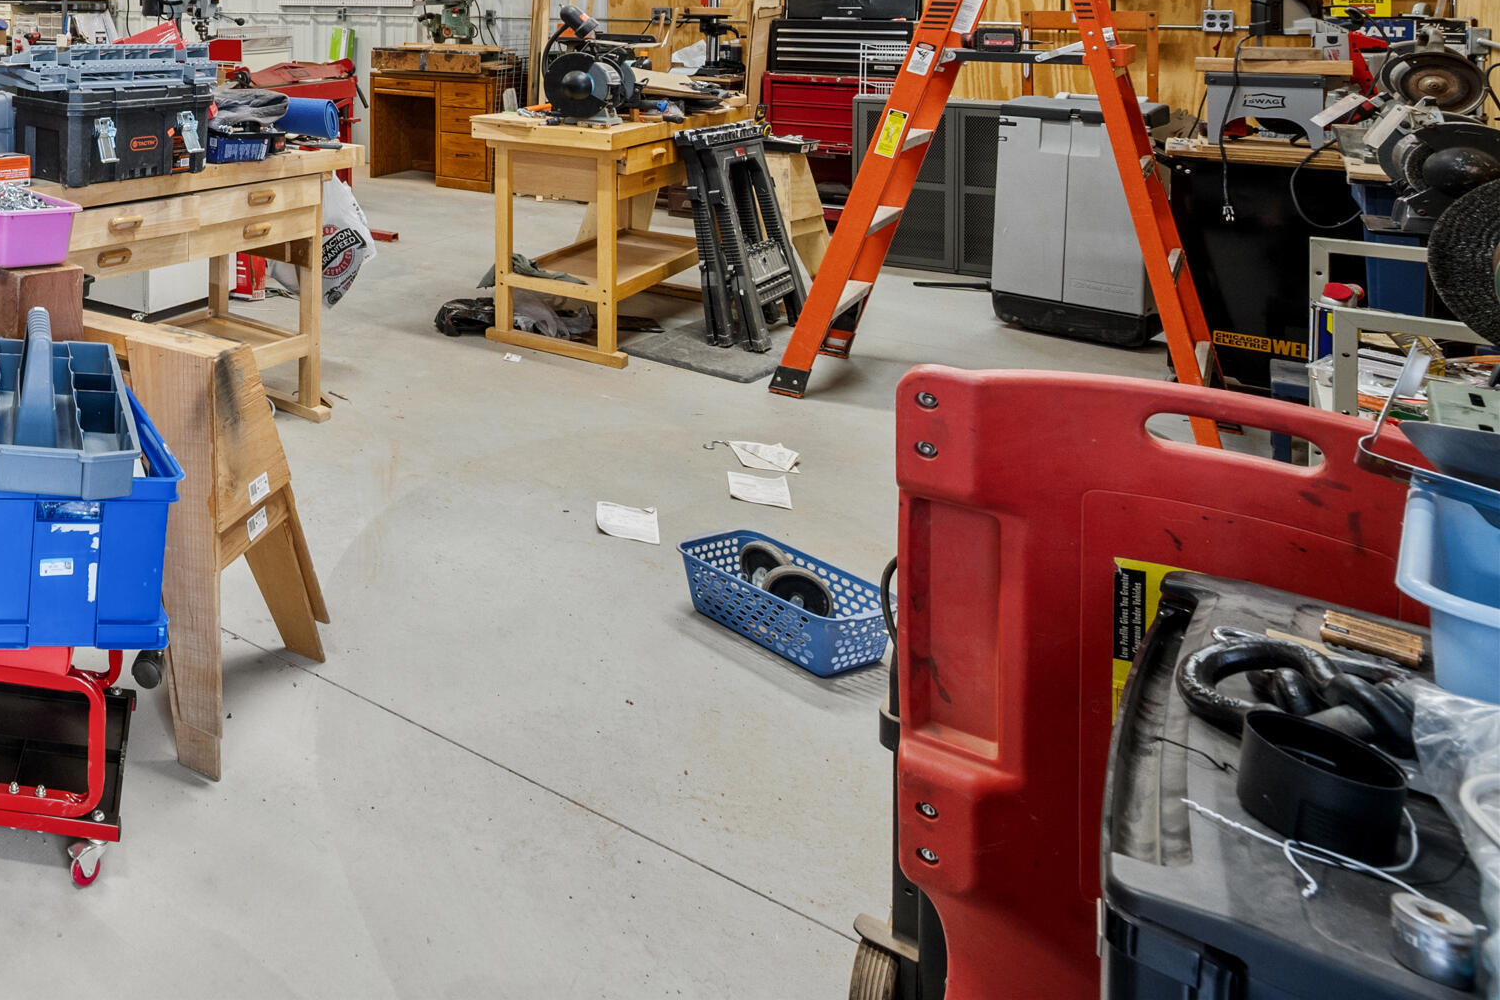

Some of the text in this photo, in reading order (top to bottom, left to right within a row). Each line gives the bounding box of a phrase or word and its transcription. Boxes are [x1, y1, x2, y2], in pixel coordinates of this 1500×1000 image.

[1215, 336, 1268, 350] ELECTRIC
[1215, 332, 1308, 358] CHICAGO WEL
[1132, 582, 1142, 606] Vehicles
[1119, 573, 1129, 658] Low Profile Gives You Greater
[1132, 607, 1141, 625] Under
